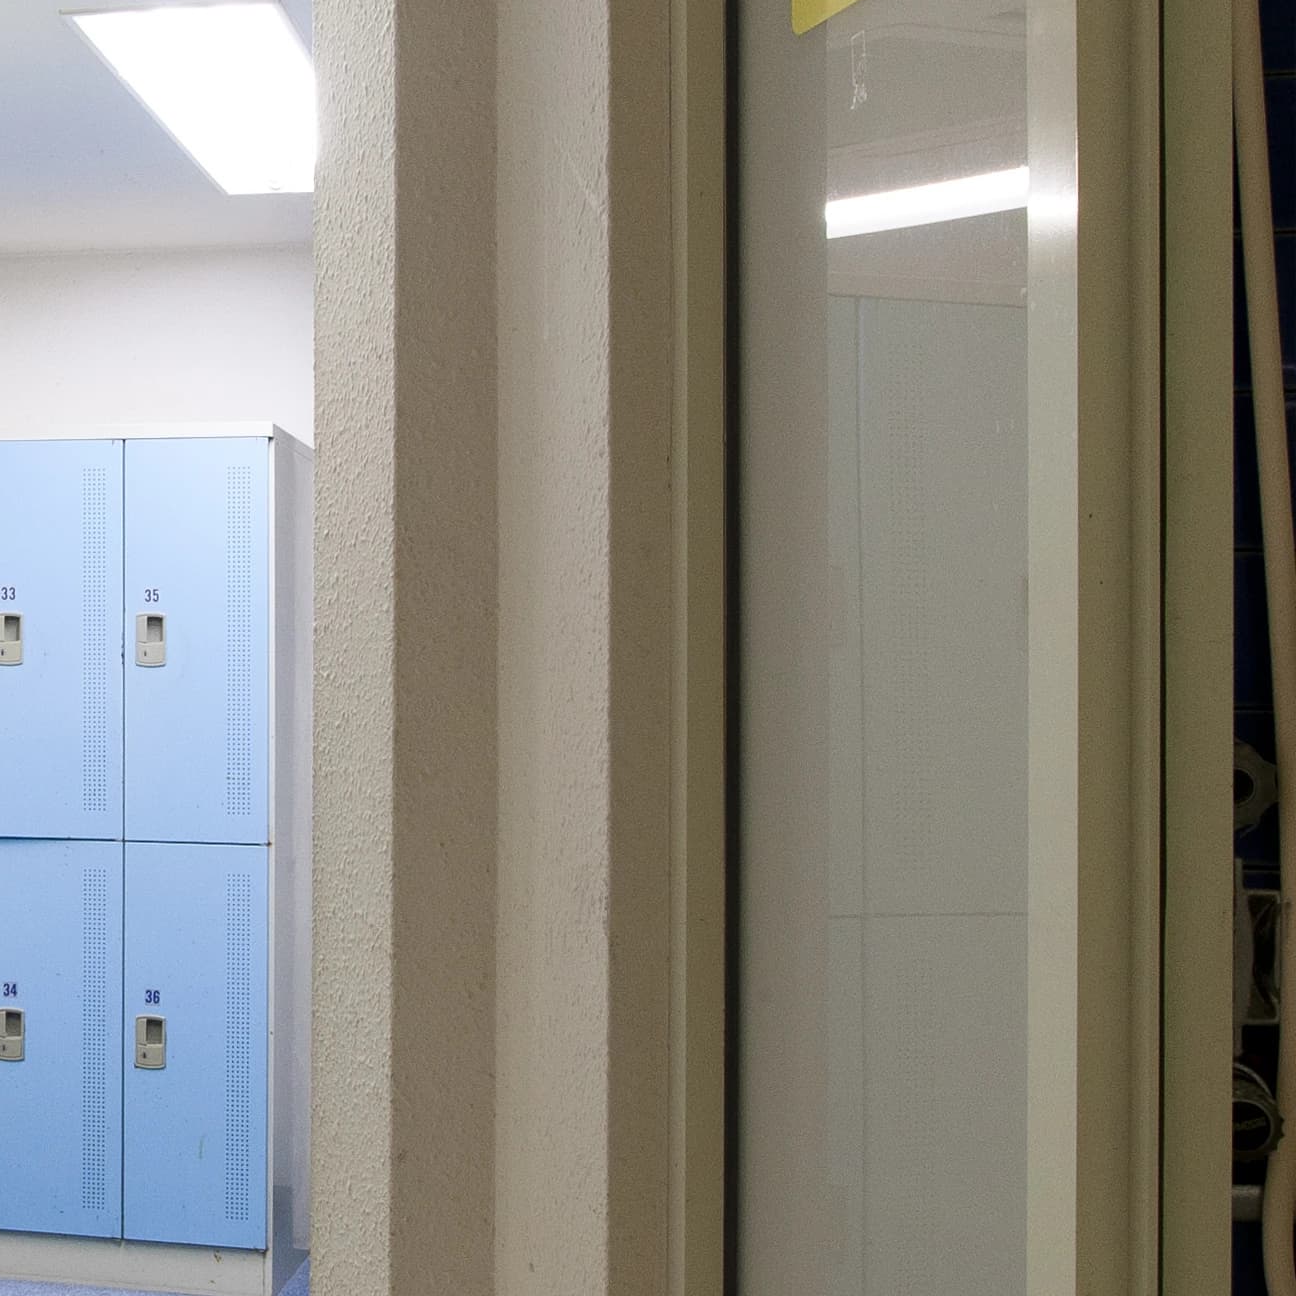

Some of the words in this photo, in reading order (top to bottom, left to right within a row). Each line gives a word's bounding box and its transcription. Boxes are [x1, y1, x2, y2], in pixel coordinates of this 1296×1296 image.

[0, 586, 17, 601] 33
[144, 588, 160, 603] 35
[3, 983, 18, 997] 34
[144, 989, 161, 1004] 36
